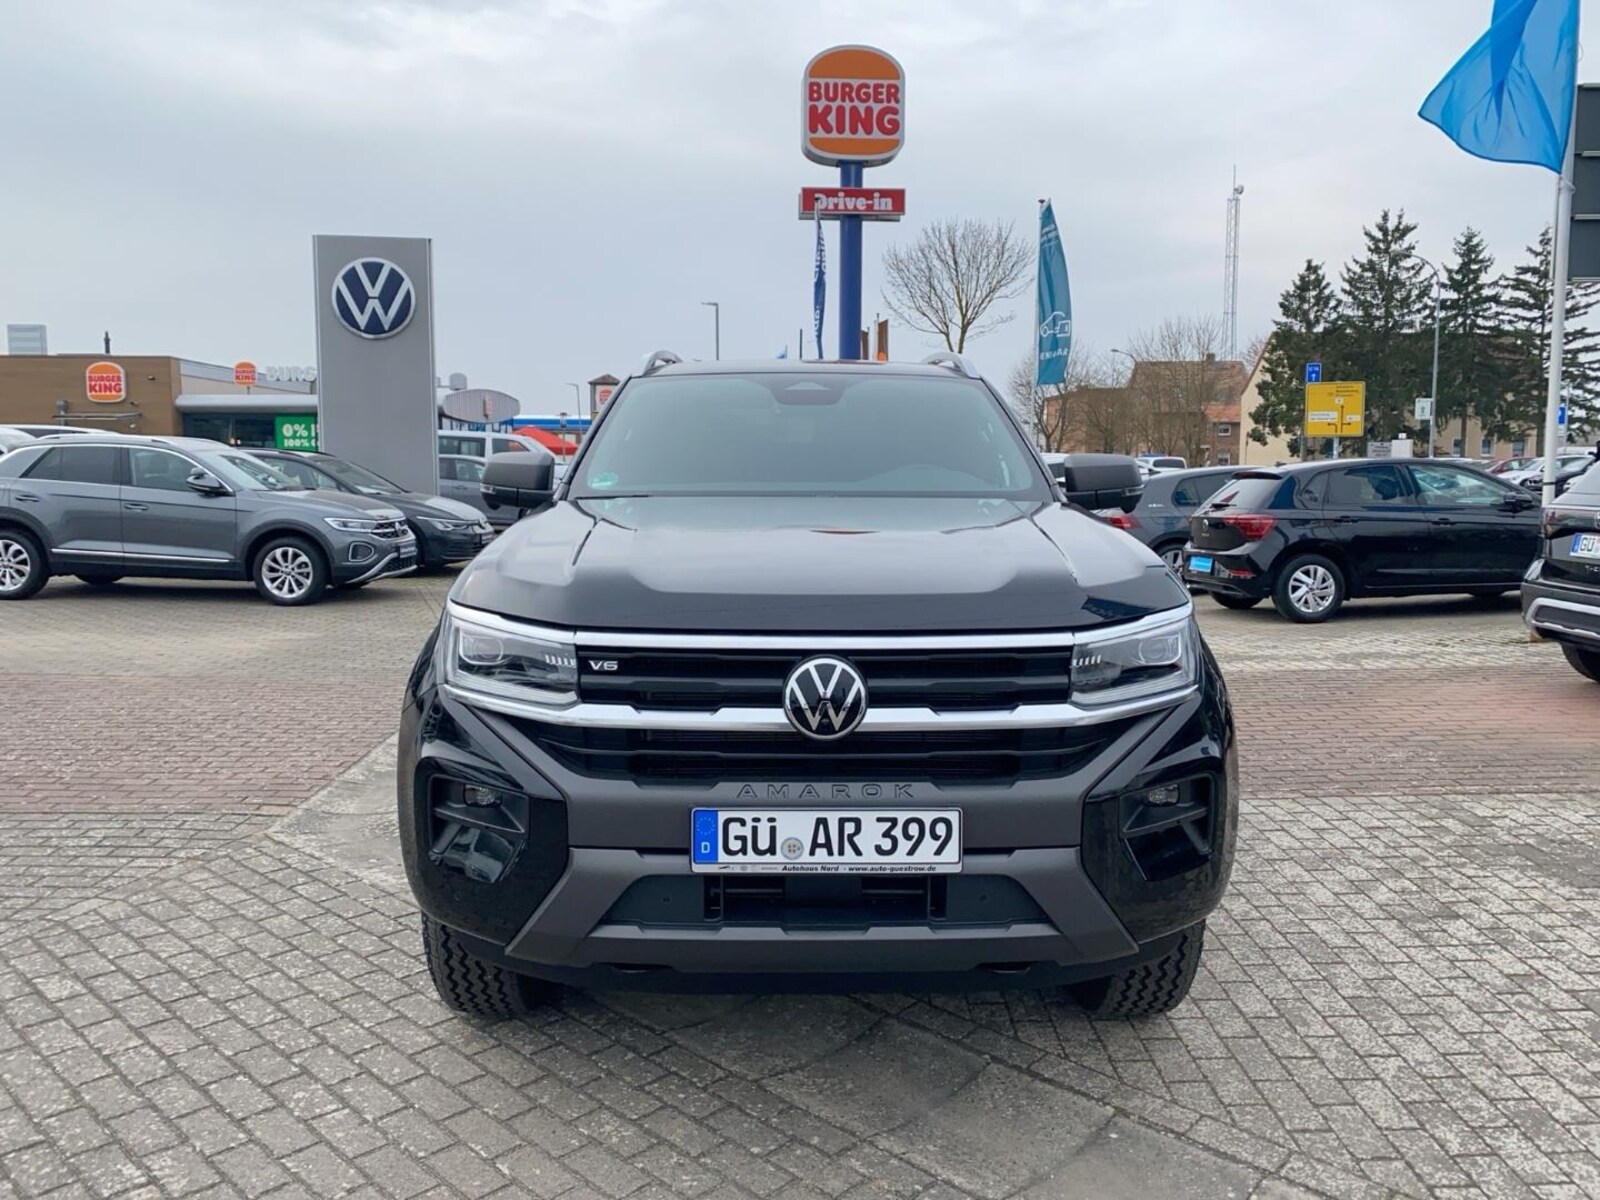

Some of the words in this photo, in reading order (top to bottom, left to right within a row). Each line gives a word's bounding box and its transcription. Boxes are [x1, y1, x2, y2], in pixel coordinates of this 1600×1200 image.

[808, 81, 900, 104] BURGER
[808, 104, 901, 136] KING
[814, 192, 893, 211] Drive-in
[88, 374, 122, 383] BURGER
[88, 383, 122, 394] KING
[588, 660, 618, 671] V6
[736, 784, 914, 799] AMAROK
[701, 842, 711, 854] D
[722, 817, 777, 857] GÜ
[809, 817, 863, 857] AR
[874, 816, 953, 857] 399
